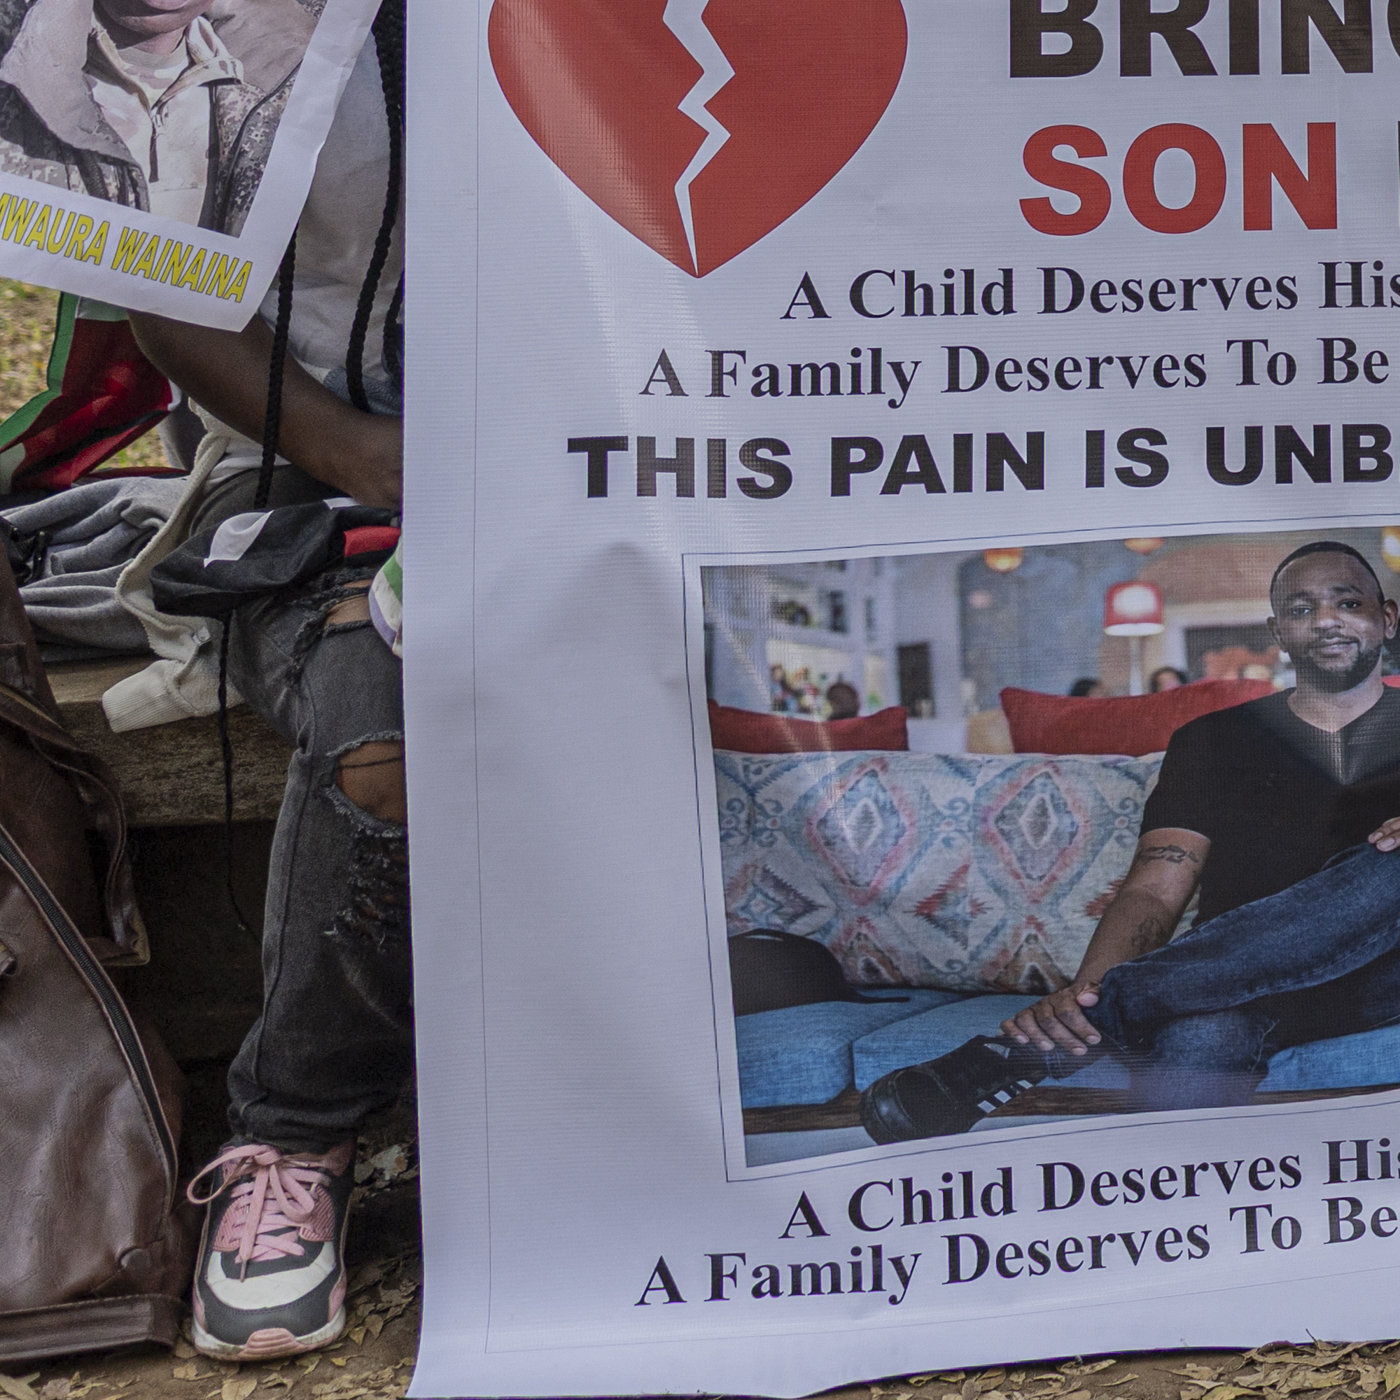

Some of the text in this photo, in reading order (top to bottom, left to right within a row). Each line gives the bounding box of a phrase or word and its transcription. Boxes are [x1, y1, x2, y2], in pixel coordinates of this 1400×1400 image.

[1019, 122, 1337, 236] SON
[0, 193, 252, 303] WAURA WAINAINA
[780, 272, 830, 319] A
[850, 268, 1017, 318] Child
[1037, 267, 1297, 314] Deserves
[639, 349, 689, 396] A
[705, 347, 922, 409] Family
[941, 346, 1206, 393] Deserves
[1227, 339, 1296, 386] To
[1317, 338, 1388, 384] Be
[567, 436, 792, 499] THIS
[831, 432, 1044, 497] PAIN
[1086, 428, 1169, 488] IS
[779, 1191, 830, 1239] A
[848, 1167, 1017, 1231] Child
[1037, 1155, 1301, 1212] Deserves
[635, 1256, 687, 1306] A
[704, 1245, 921, 1305] Family
[941, 1224, 1209, 1284] Deserves
[1230, 1204, 1301, 1254] To
[1322, 1197, 1397, 1244] Be
